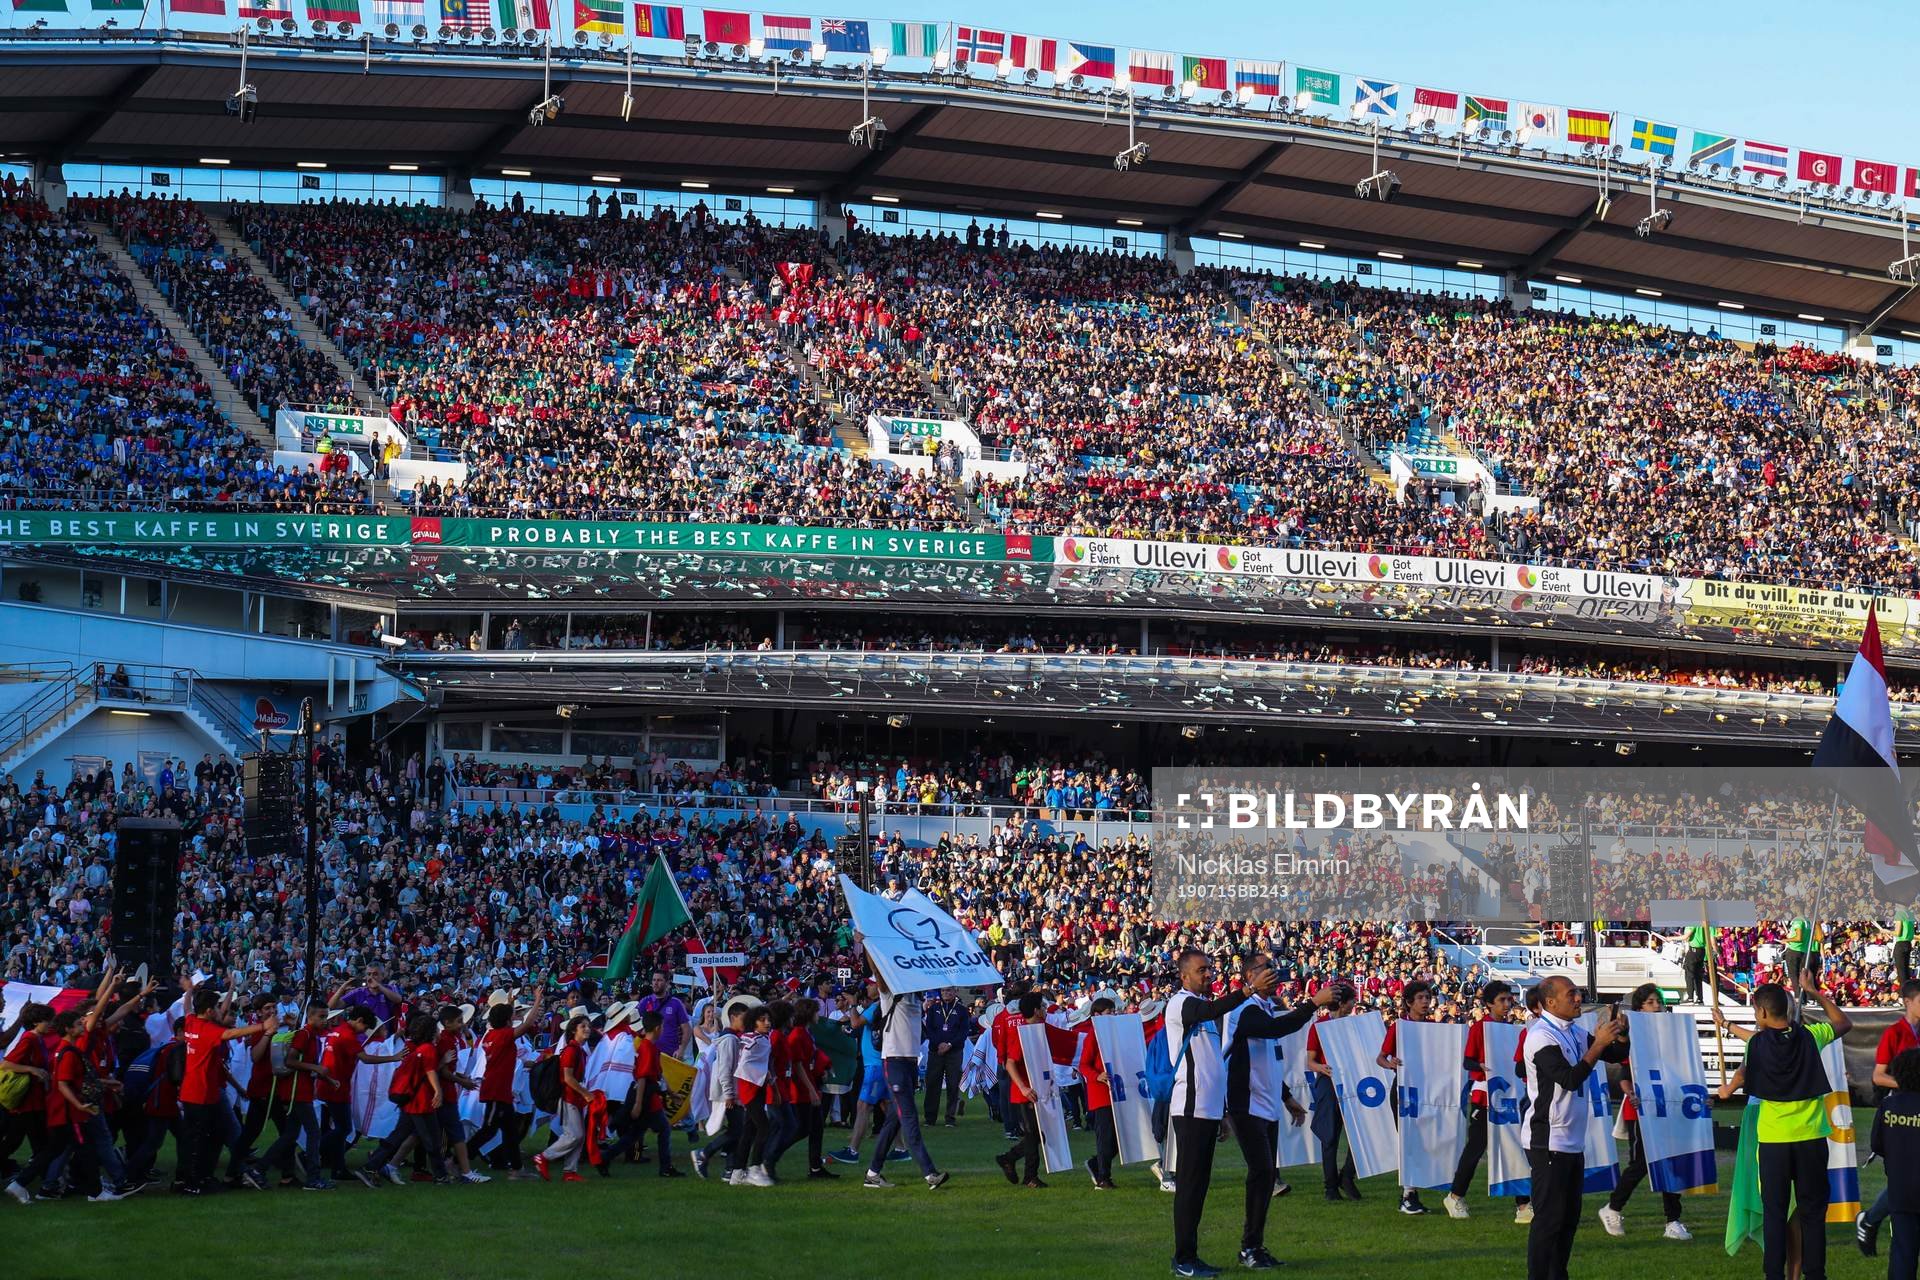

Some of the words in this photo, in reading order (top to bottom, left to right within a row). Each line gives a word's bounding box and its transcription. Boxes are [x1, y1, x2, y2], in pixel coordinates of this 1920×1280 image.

[306, 418, 325, 429] N5
[893, 423, 909, 432] N2
[1414, 461, 1428, 470] O2
[50, 520, 117, 536] BEST
[134, 521, 217, 537] KAFFE
[234, 522, 259, 537] IN
[275, 522, 388, 540] SVERIGE
[412, 531, 440, 540] GEVALIA
[491, 527, 620, 544] PROBABLY
[634, 529, 679, 545] THE
[694, 530, 751, 546] BEST
[765, 532, 837, 550] KAFFE
[852, 535, 873, 551] IN
[888, 538, 986, 556] SVERIGE
[1006, 547, 1030, 556] GEVALIA
[1089, 542, 1108, 553] Got
[1090, 553, 1120, 565] Event
[1134, 543, 1207, 569] Ullevi
[1242, 551, 1261, 561] Got
[1243, 562, 1273, 573] Event
[1286, 552, 1357, 577] Ullevi
[1392, 559, 1411, 570] Got
[1393, 570, 1423, 582] Event
[1435, 560, 1505, 587] Ullevi
[1541, 570, 1559, 581] Got
[1542, 581, 1571, 592] Event
[1583, 572, 1652, 599] Ullevi
[1704, 582, 1729, 597] Dit
[1734, 585, 1756, 600] du
[1760, 588, 1793, 604] vill,
[1798, 591, 1828, 606] när
[1833, 594, 1854, 609] du
[1859, 598, 1892, 613] vll.
[259, 713, 287, 724] Malaco
[692, 956, 738, 965] Bangladesh
[893, 953, 958, 969] Gothia
[1519, 950, 1568, 967] Ullevi
[1007, 1018, 1024, 1028] PER
